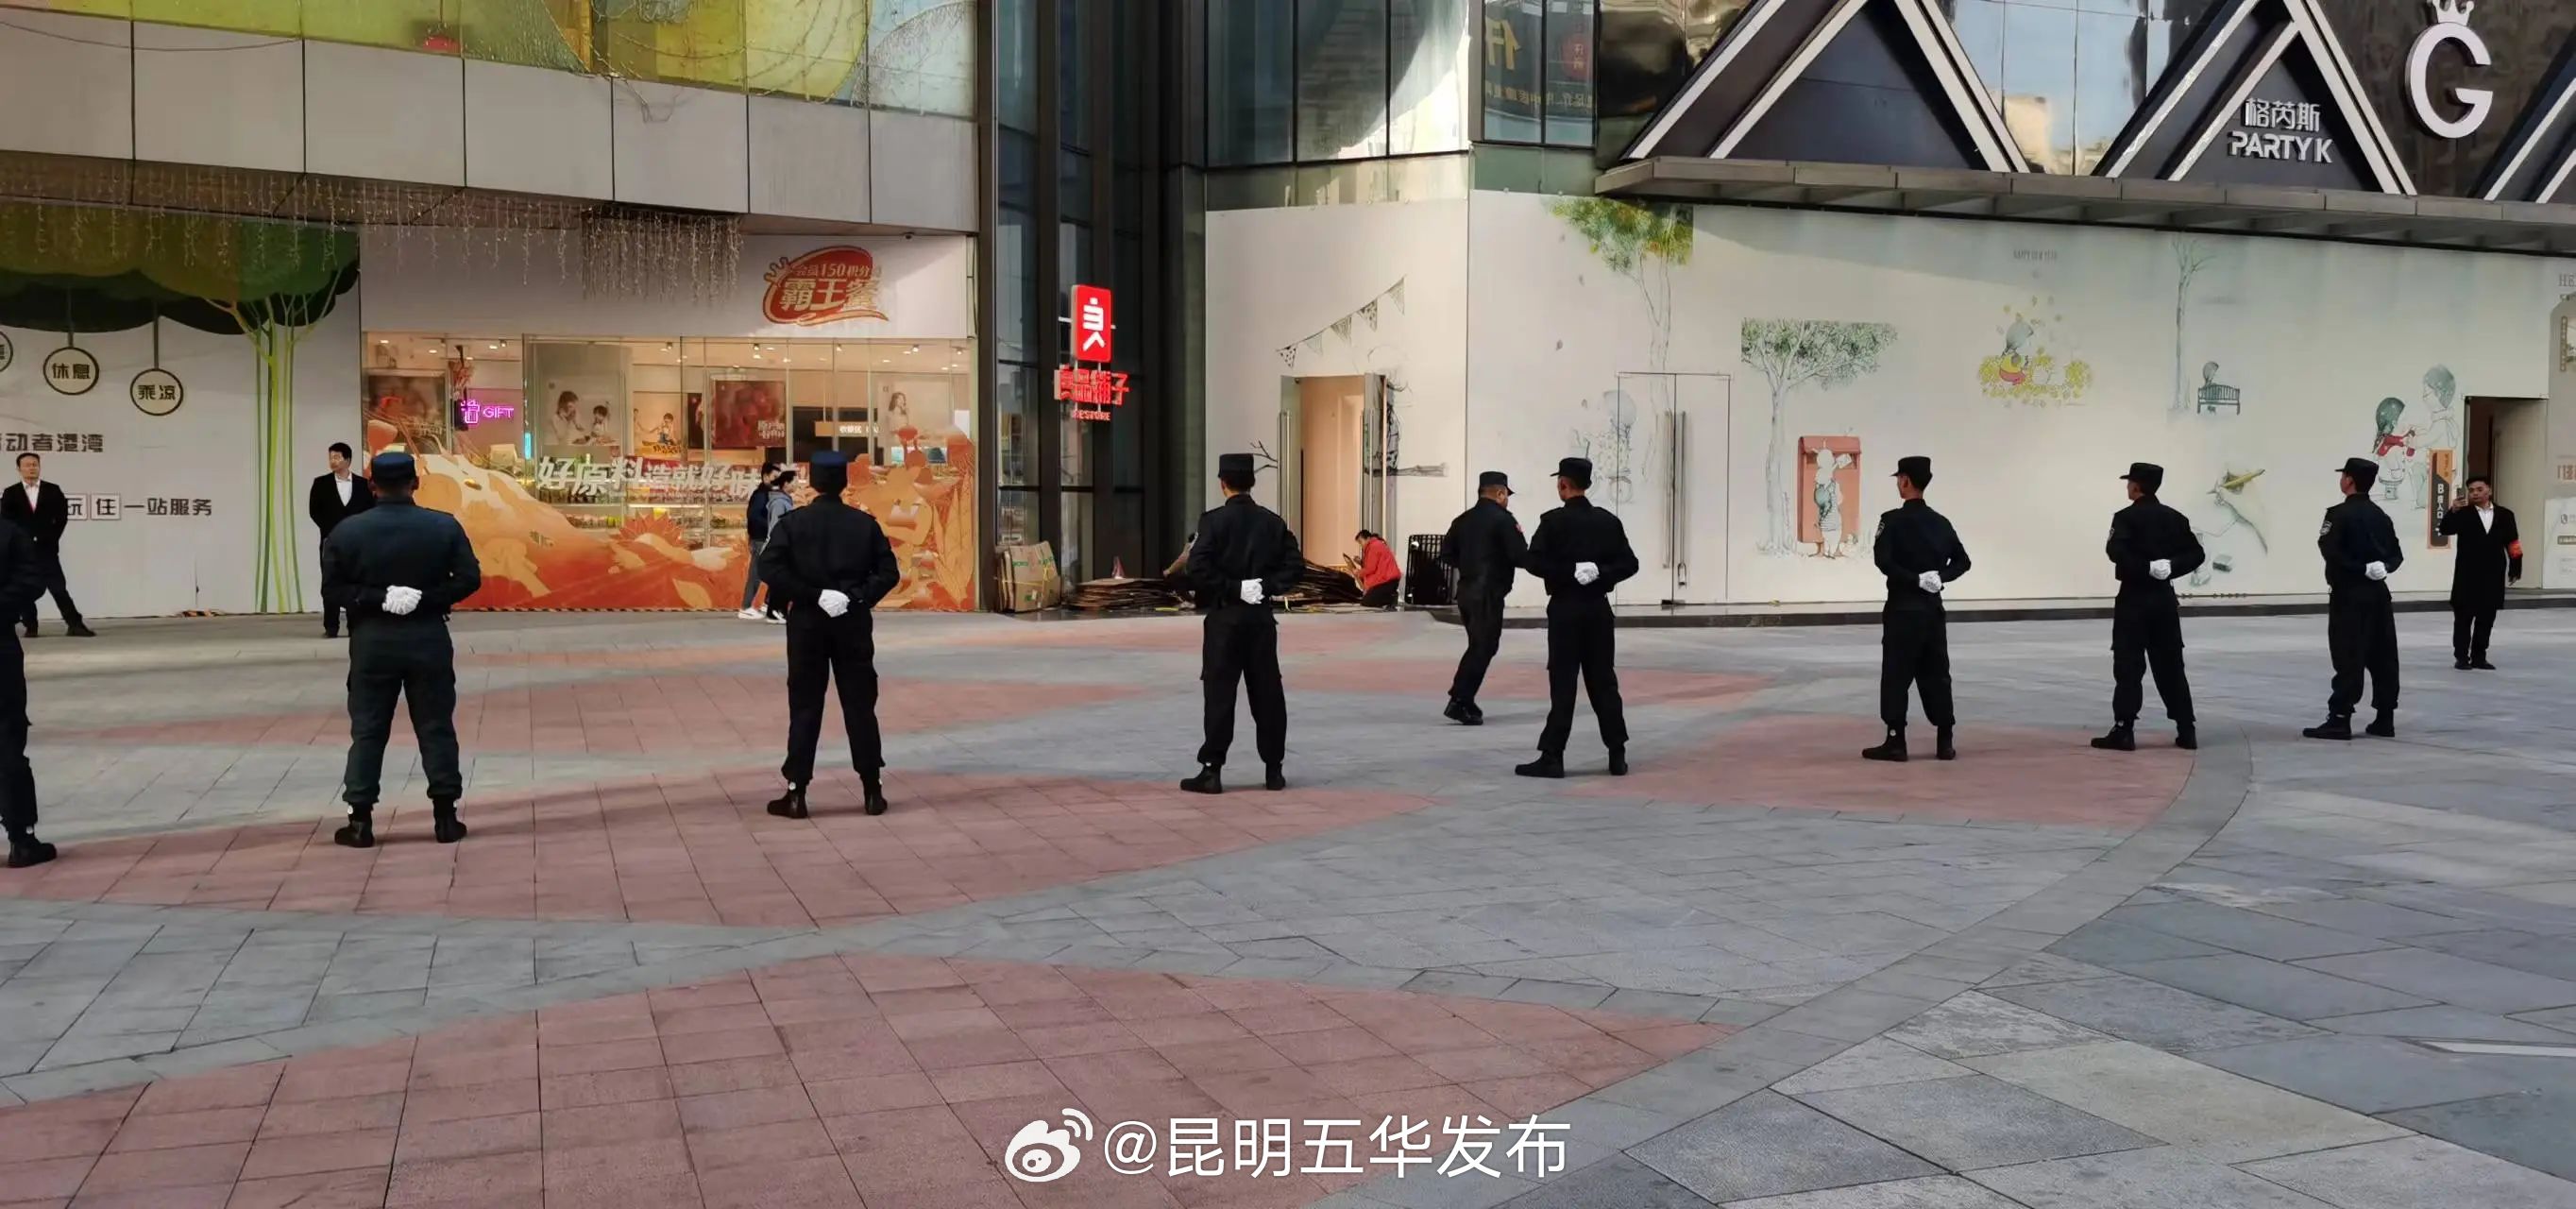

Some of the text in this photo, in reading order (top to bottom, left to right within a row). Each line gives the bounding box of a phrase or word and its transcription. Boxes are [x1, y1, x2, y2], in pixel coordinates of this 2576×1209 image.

[2405, 22, 2493, 139] G
[2244, 98, 2320, 131] 格芮斯
[52, 363, 91, 380] 休息
[137, 384, 177, 400] 乘凉
[483, 407, 515, 418] GIFT
[0, 433, 104, 452] 动者港湾
[537, 455, 801, 499] 好原料造就好味
